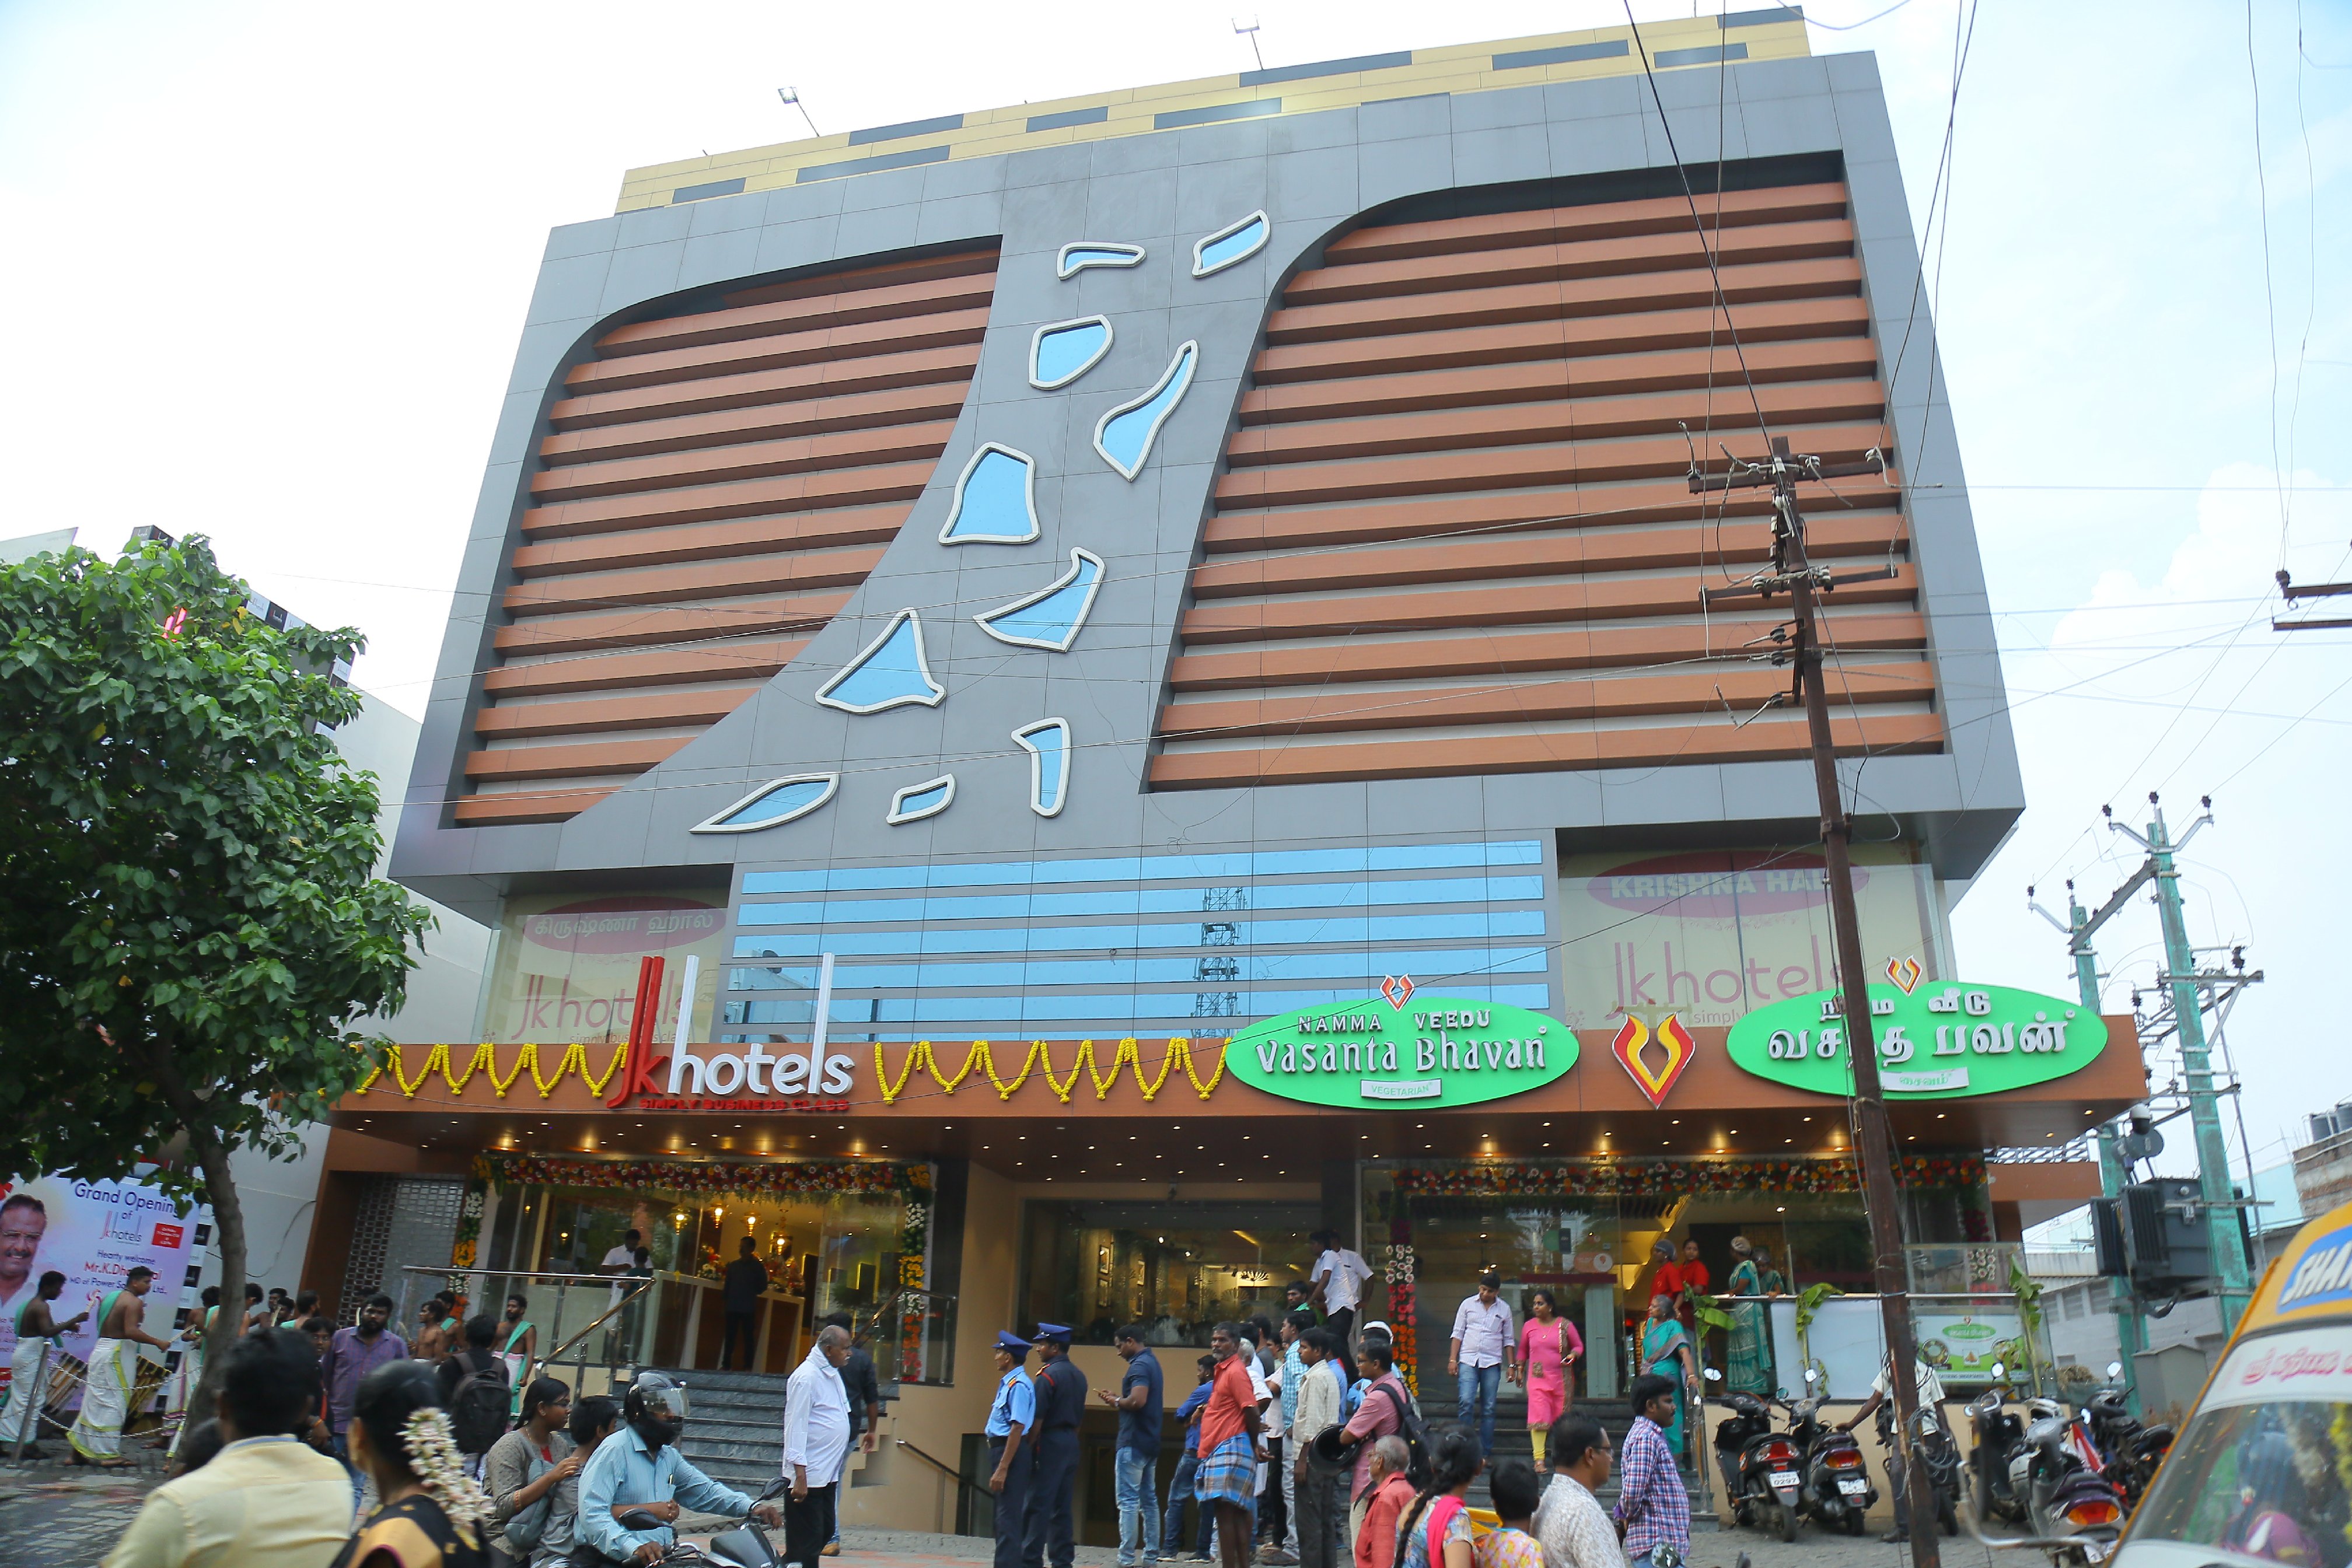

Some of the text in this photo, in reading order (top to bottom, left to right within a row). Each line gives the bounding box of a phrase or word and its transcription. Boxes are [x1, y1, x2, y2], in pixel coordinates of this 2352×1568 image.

[1610, 867, 1831, 899] KRISHNA HAL
[534, 911, 714, 939] கிருஷ்ணா ஹால்
[1928, 988, 1991, 1015] வீடு
[1298, 1009, 1491, 1033] NAMMA VEEDU
[1768, 1010, 2069, 1068] வசத பவன்
[1255, 1030, 1547, 1073] Vasanta Bhavan
[639, 1098, 850, 1111] SIMPLY BUSINESS CLASS
[74, 1182, 121, 1204] Grand
[121, 1210, 133, 1220] of
[97, 1249, 156, 1265] Hearty welcome
[90, 1276, 115, 1288] Power
